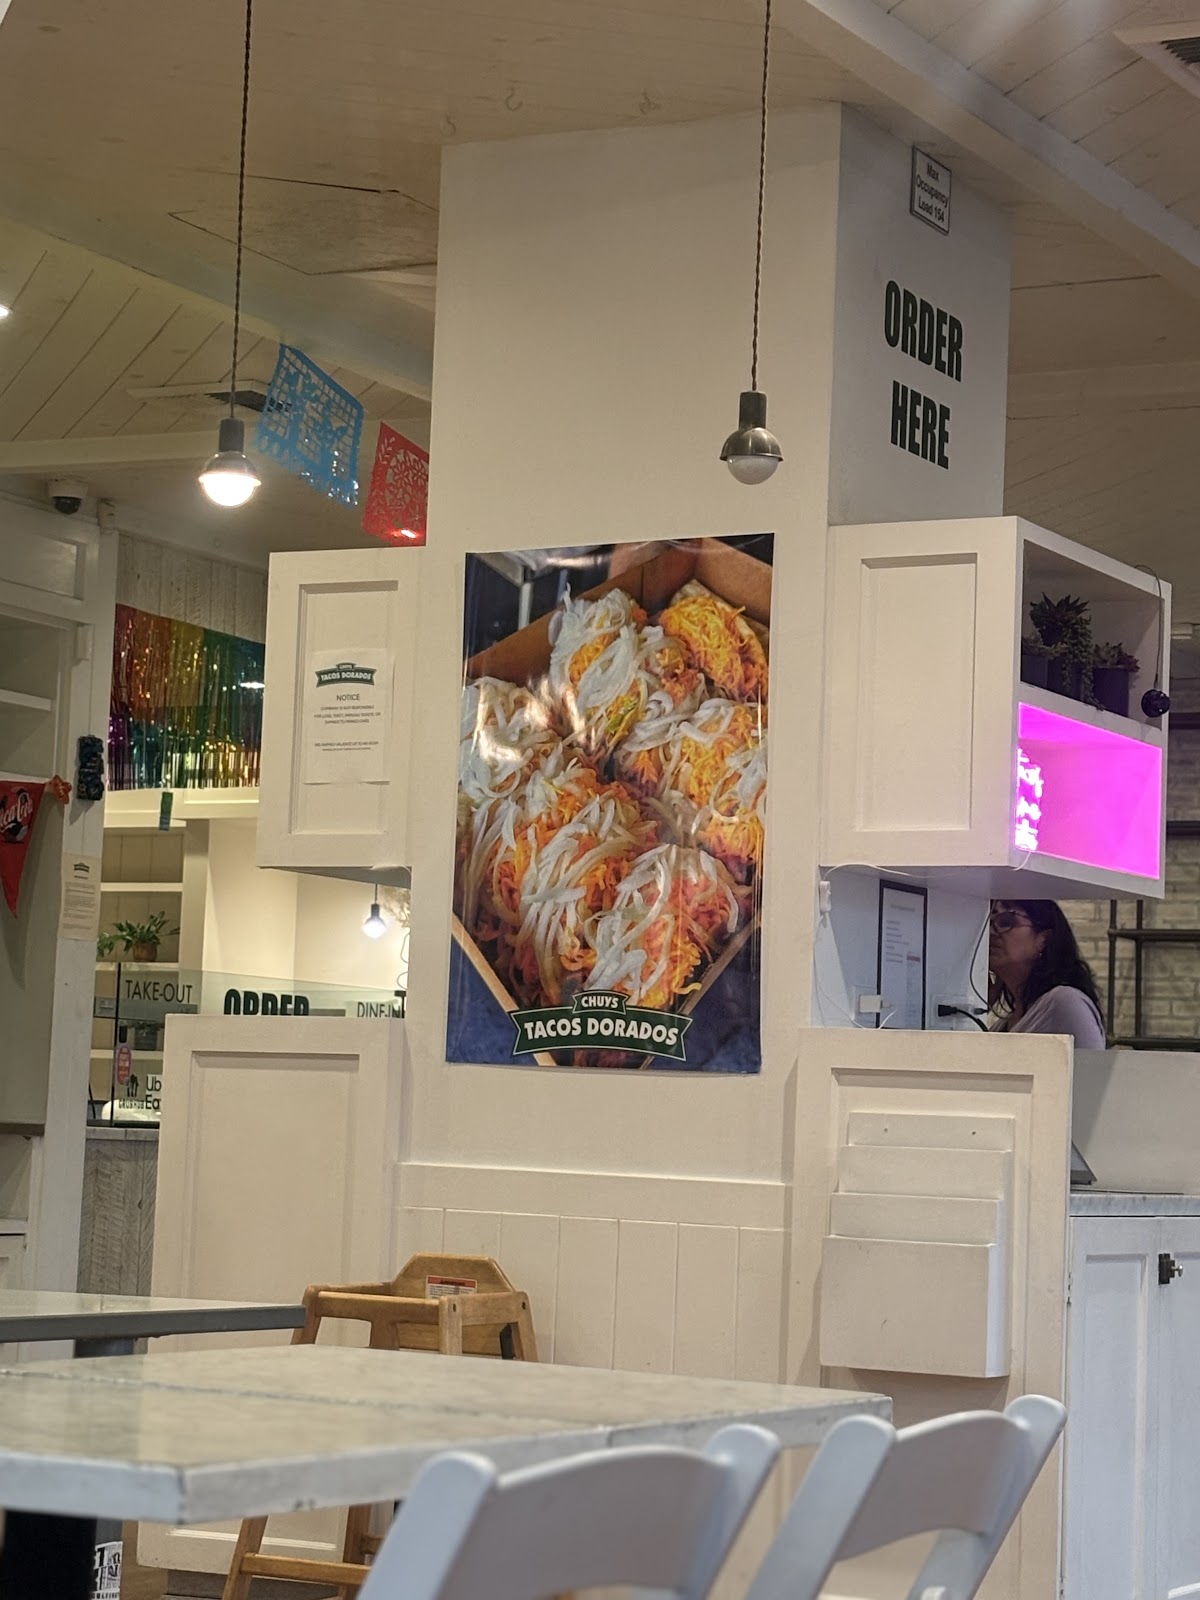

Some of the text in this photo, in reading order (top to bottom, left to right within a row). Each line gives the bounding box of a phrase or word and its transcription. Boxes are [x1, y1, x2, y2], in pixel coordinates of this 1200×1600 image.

[927, 162, 939, 181] Max
[917, 174, 949, 208] Occupancy
[919, 195, 945, 223] Load 154
[885, 280, 963, 382] ORDER
[891, 380, 950, 470] HERE
[321, 672, 371, 681] TACOS DORADOS
[125, 979, 193, 1004] TAKE-OUT
[581, 996, 619, 1008] CHUYS
[524, 1017, 679, 1046] TACOS DORADOS
[146, 1075, 162, 1092] Ub
